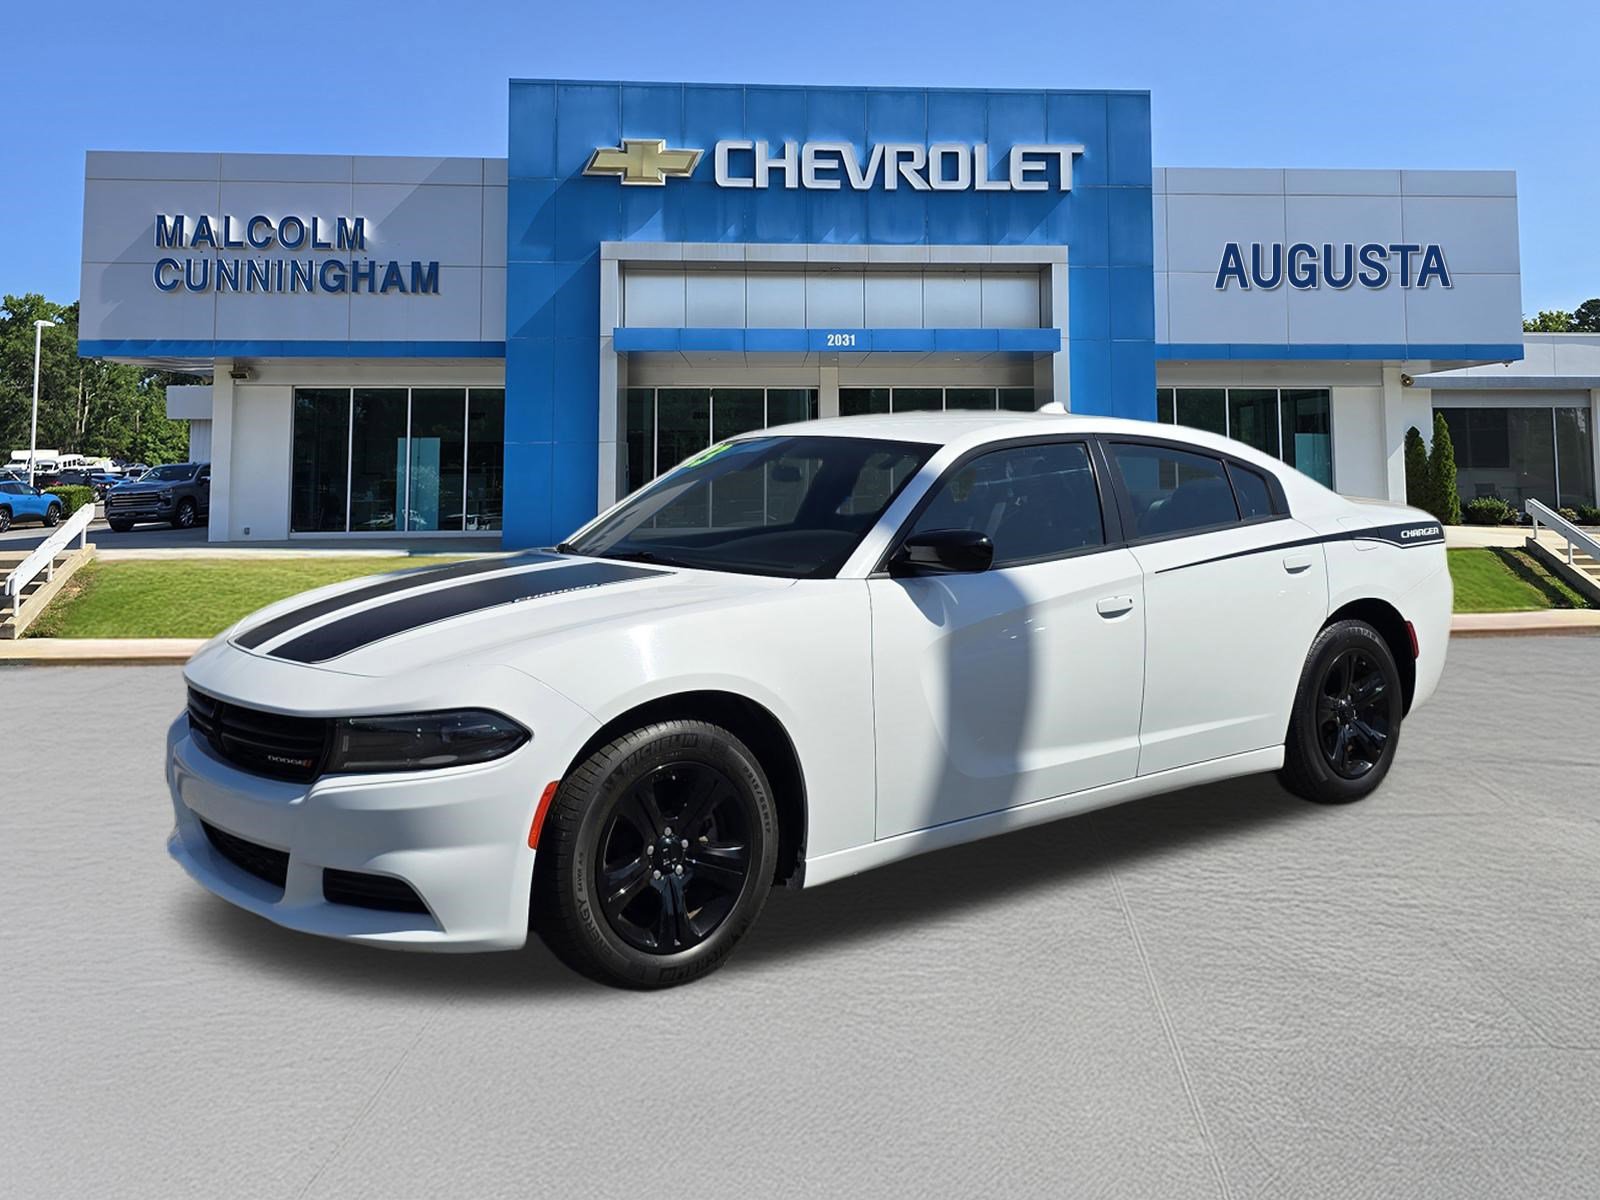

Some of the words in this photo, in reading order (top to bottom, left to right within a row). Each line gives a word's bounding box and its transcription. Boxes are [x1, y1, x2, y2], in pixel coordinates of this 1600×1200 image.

[714, 139, 1084, 192] CHEVROLET
[154, 214, 367, 250] MALCOLM
[153, 257, 441, 293] CUNNINGHAM
[1215, 241, 1453, 290] AUGUSTA
[827, 333, 856, 346] 2031
[1401, 526, 1439, 538] CHARGER
